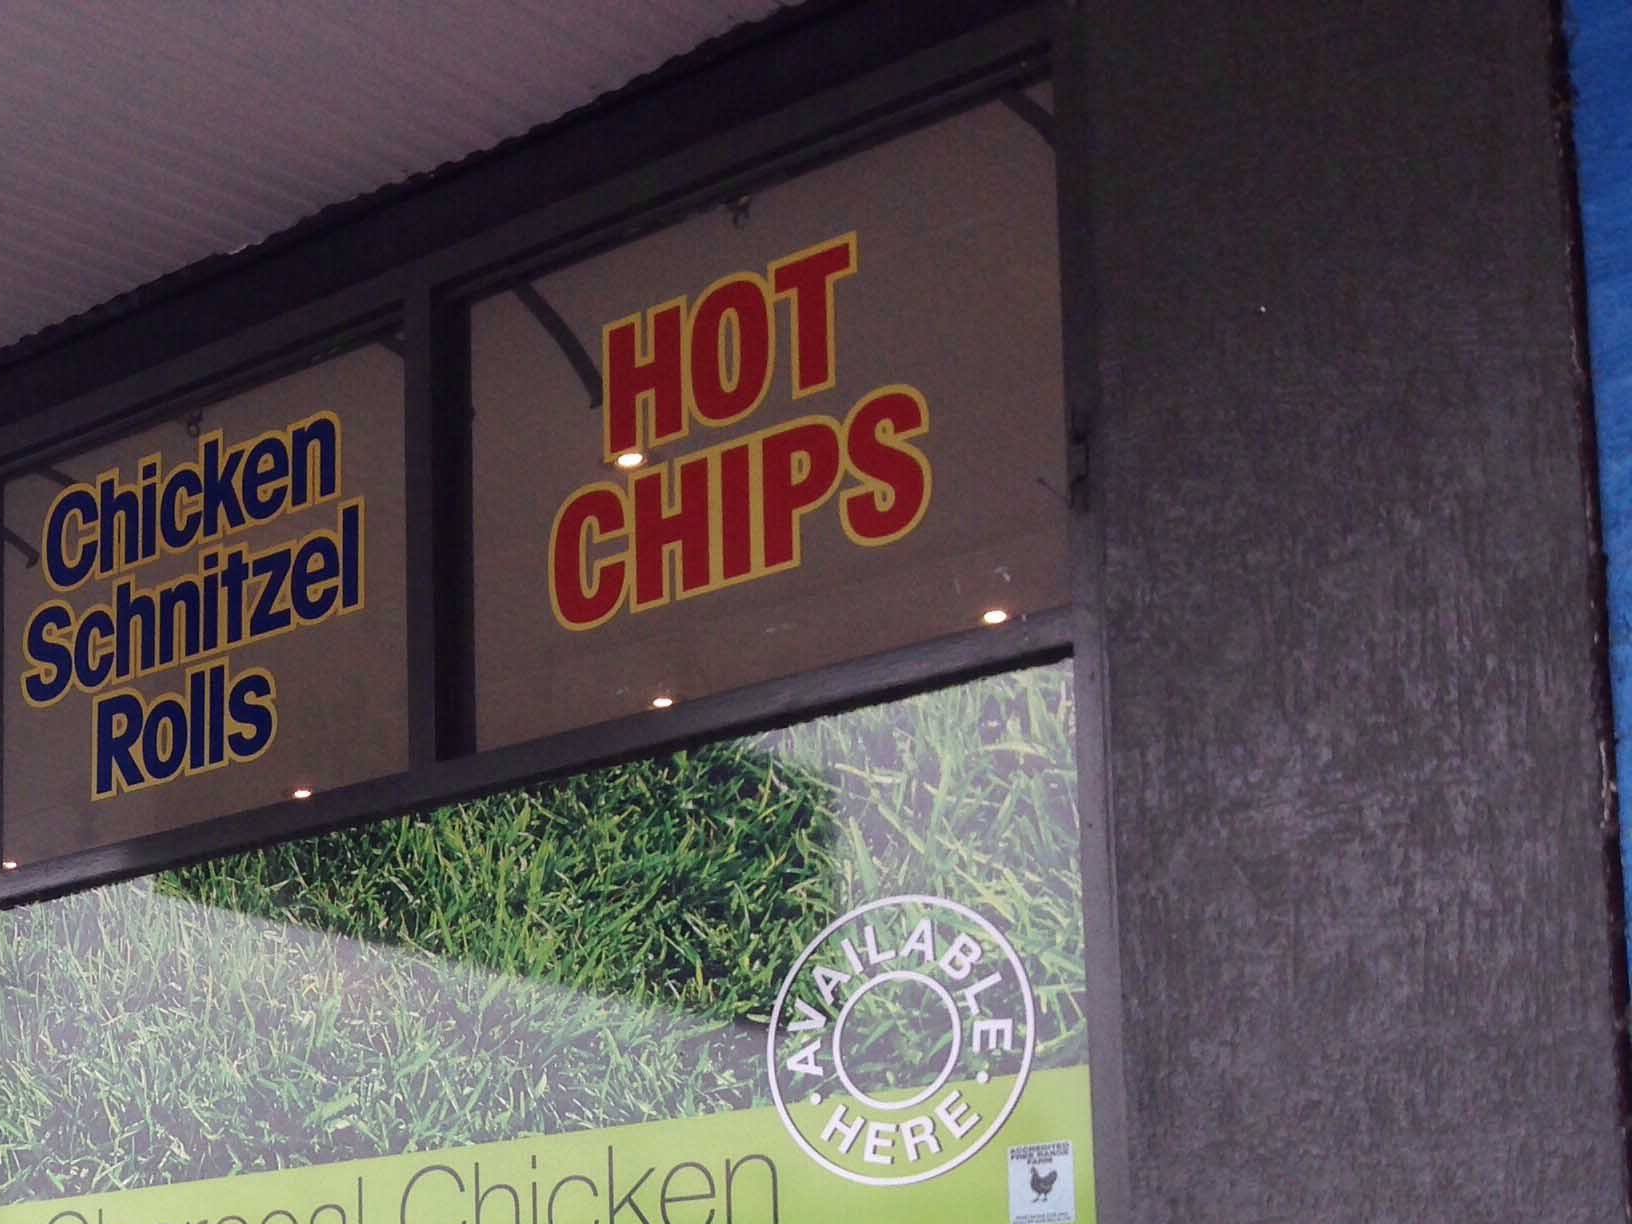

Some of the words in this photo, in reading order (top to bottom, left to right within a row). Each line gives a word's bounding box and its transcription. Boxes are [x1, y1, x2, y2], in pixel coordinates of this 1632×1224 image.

[601, 231, 858, 464] HOT
[42, 411, 342, 592] Chicken
[547, 384, 932, 631] CHIPS
[21, 496, 365, 709] Schnitzel
[90, 665, 277, 799] Rolls
[787, 919, 1013, 1077] AVAILABLE
[821, 1091, 982, 1165] HERE
